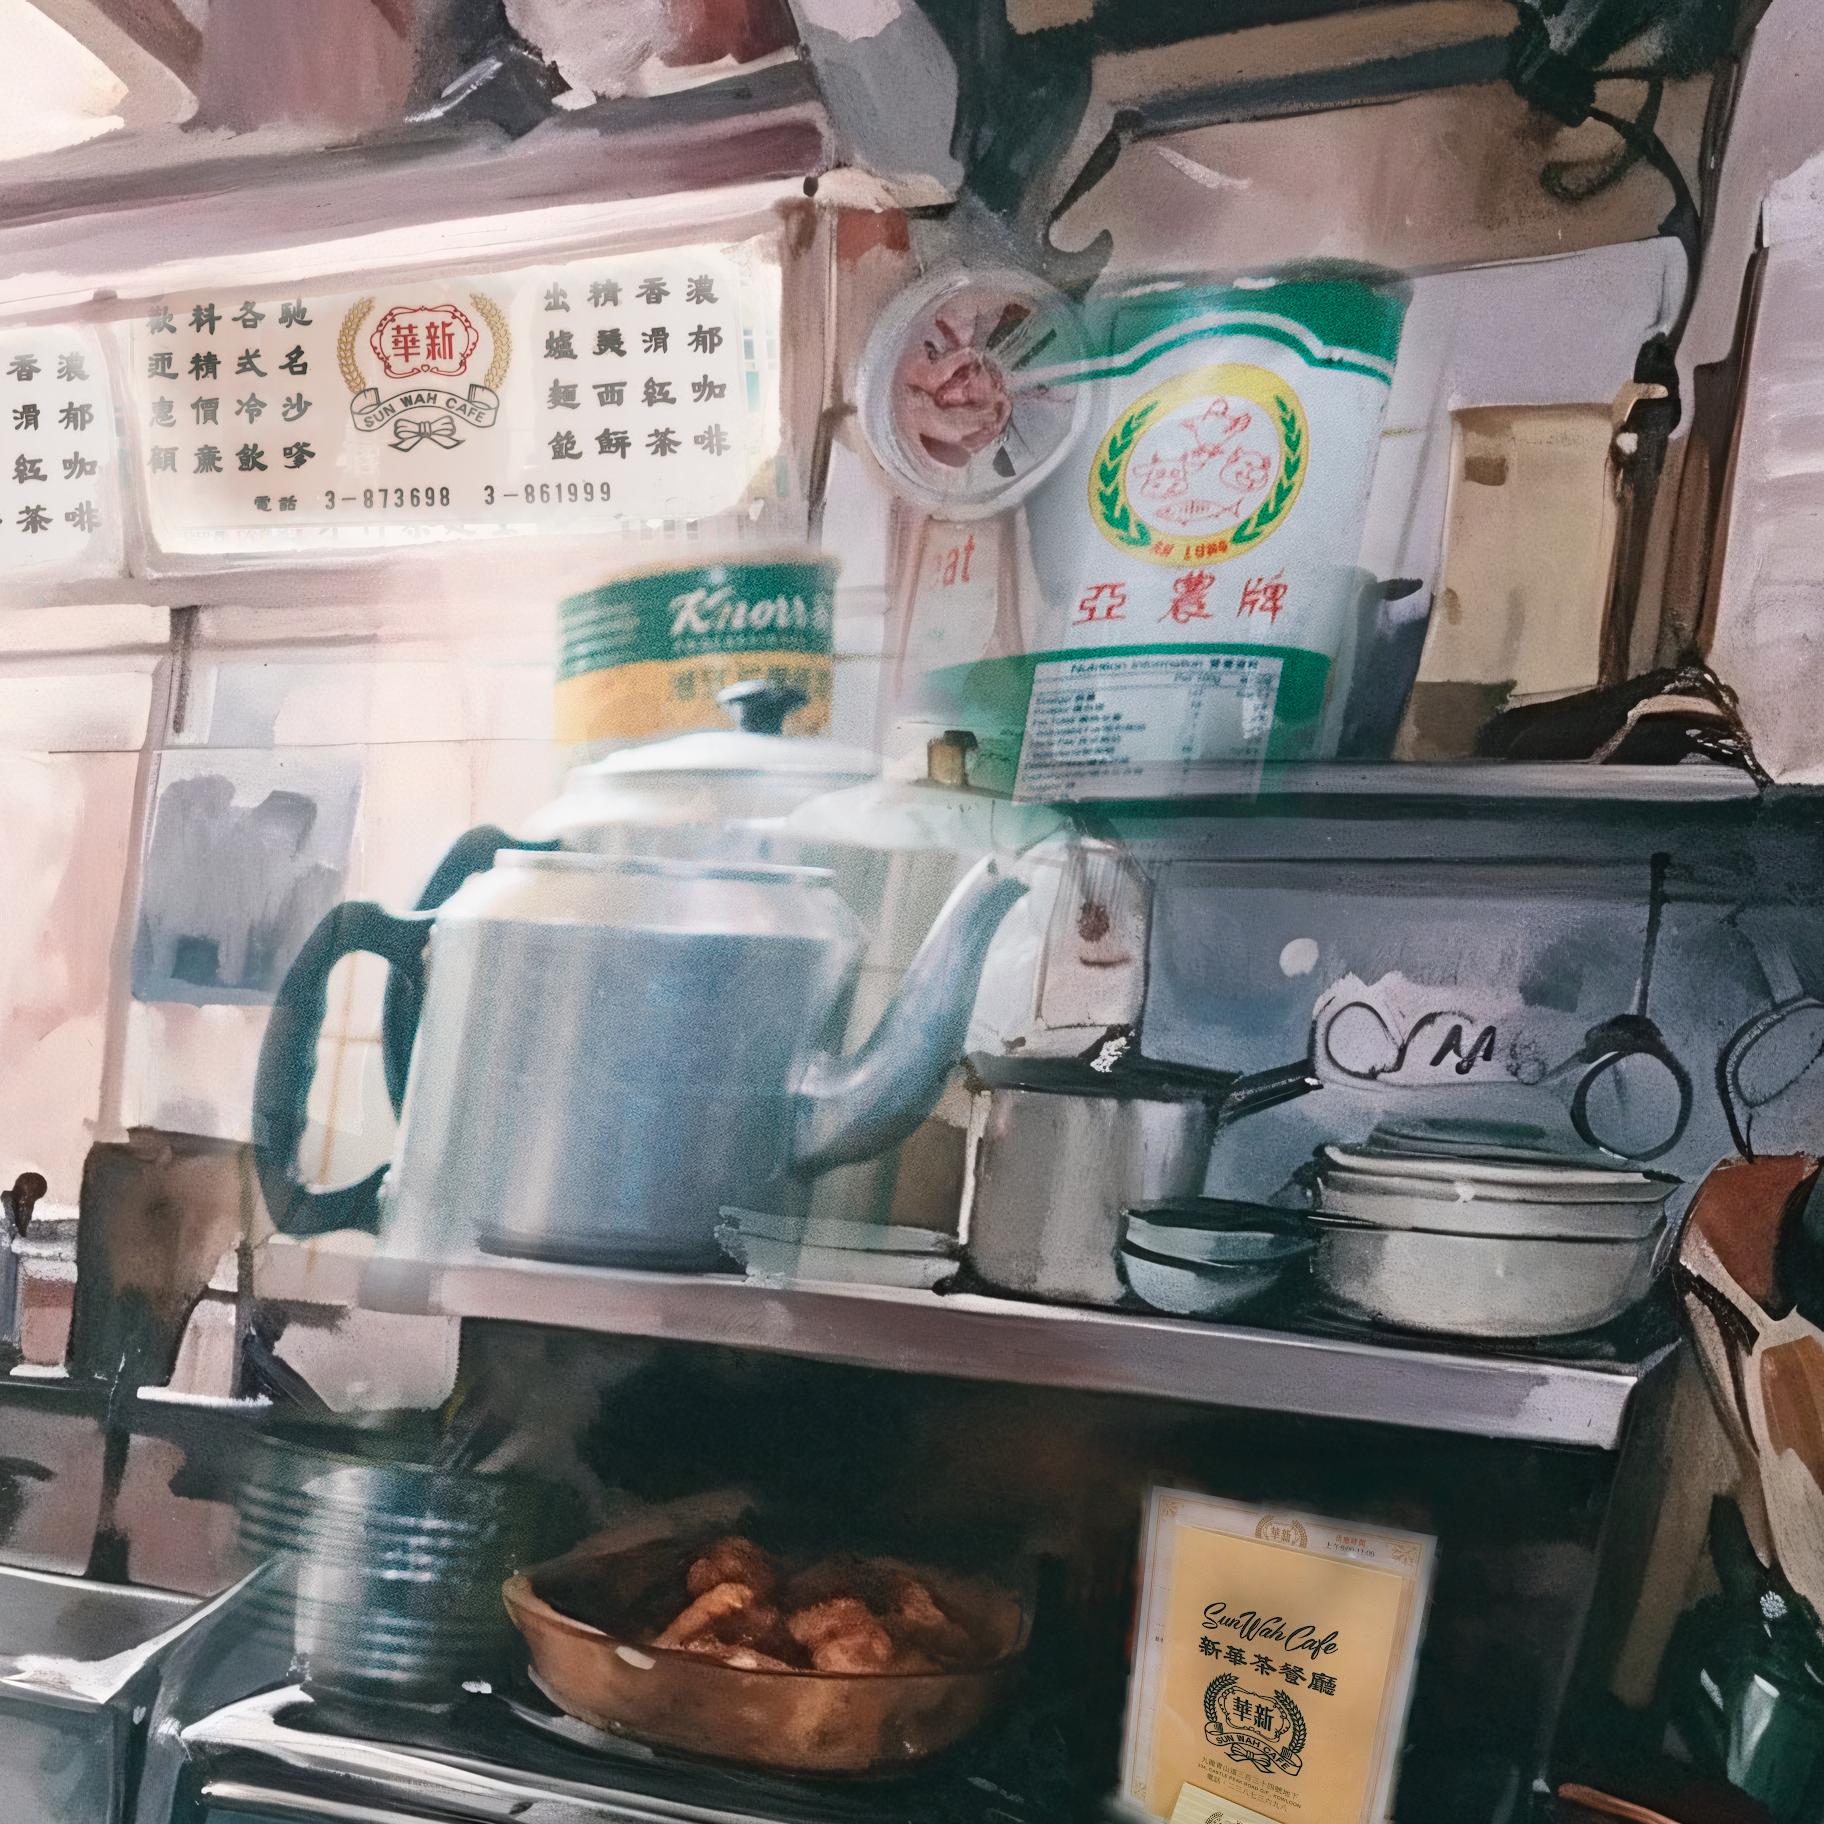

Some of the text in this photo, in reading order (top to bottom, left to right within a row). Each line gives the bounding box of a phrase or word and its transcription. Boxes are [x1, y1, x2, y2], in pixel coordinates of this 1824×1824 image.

[232, 301, 269, 471] 各式冷飲
[635, 276, 682, 456] 香滑紅茶
[685, 274, 732, 456] 濃郁咖啡
[364, 393, 486, 428] SUN WAH CAFE
[7, 353, 53, 534] 香滑紅茶
[56, 351, 102, 533] 濃郁咖啡
[254, 482, 612, 512] 電話 3-873698 3-861999
[669, 586, 809, 635] Knorr
[1201, 1602, 1339, 1660] Sun Wah Cafe
[1199, 1635, 1338, 1696] 新華茶餐廳
[1215, 1734, 1291, 1770] SUN WAH CAFE
